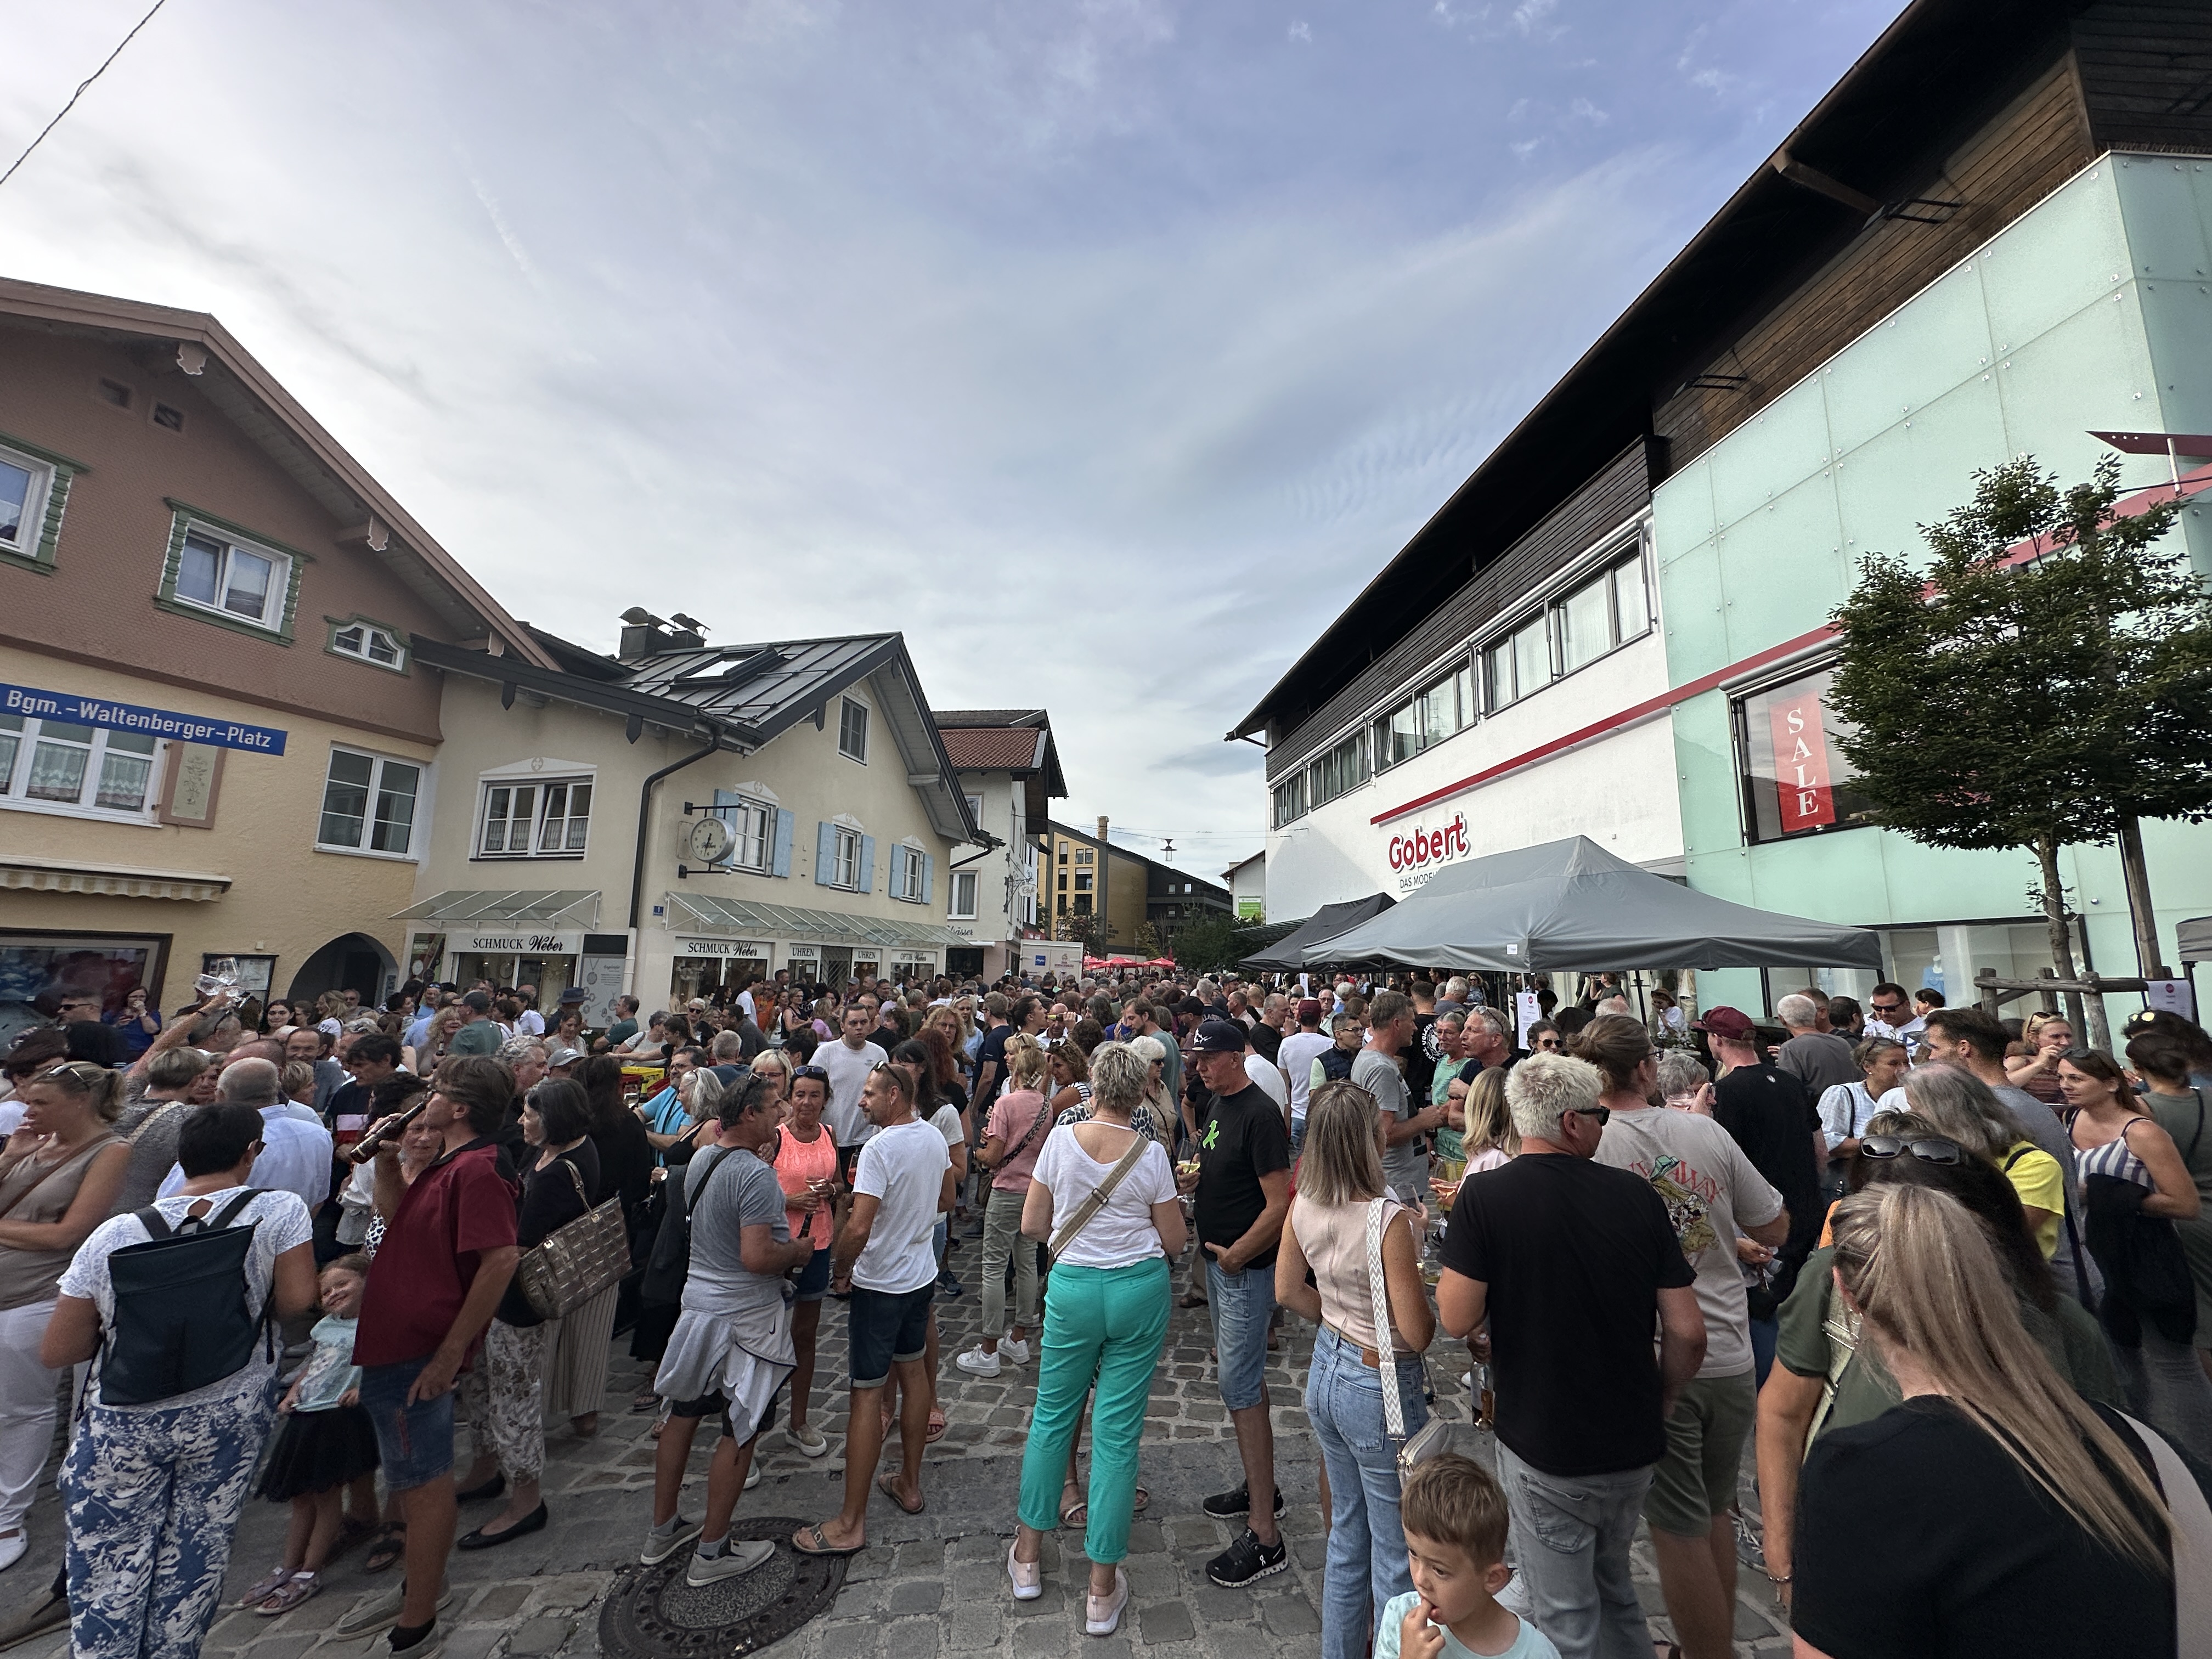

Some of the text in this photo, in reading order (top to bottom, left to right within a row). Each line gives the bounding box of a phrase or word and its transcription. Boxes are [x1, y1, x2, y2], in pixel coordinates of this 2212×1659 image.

[7, 690, 272, 748] Bgm.-Waltenberger-Platz
[1787, 707, 1819, 817] SALE
[1389, 815, 1466, 870] Gobert
[1400, 877, 1412, 888] DAS
[473, 935, 563, 951] SCHMUCK Weber
[688, 942, 758, 956] SCHMUCK Weber
[792, 947, 815, 957] UHREN
[858, 951, 876, 959] UHREN
